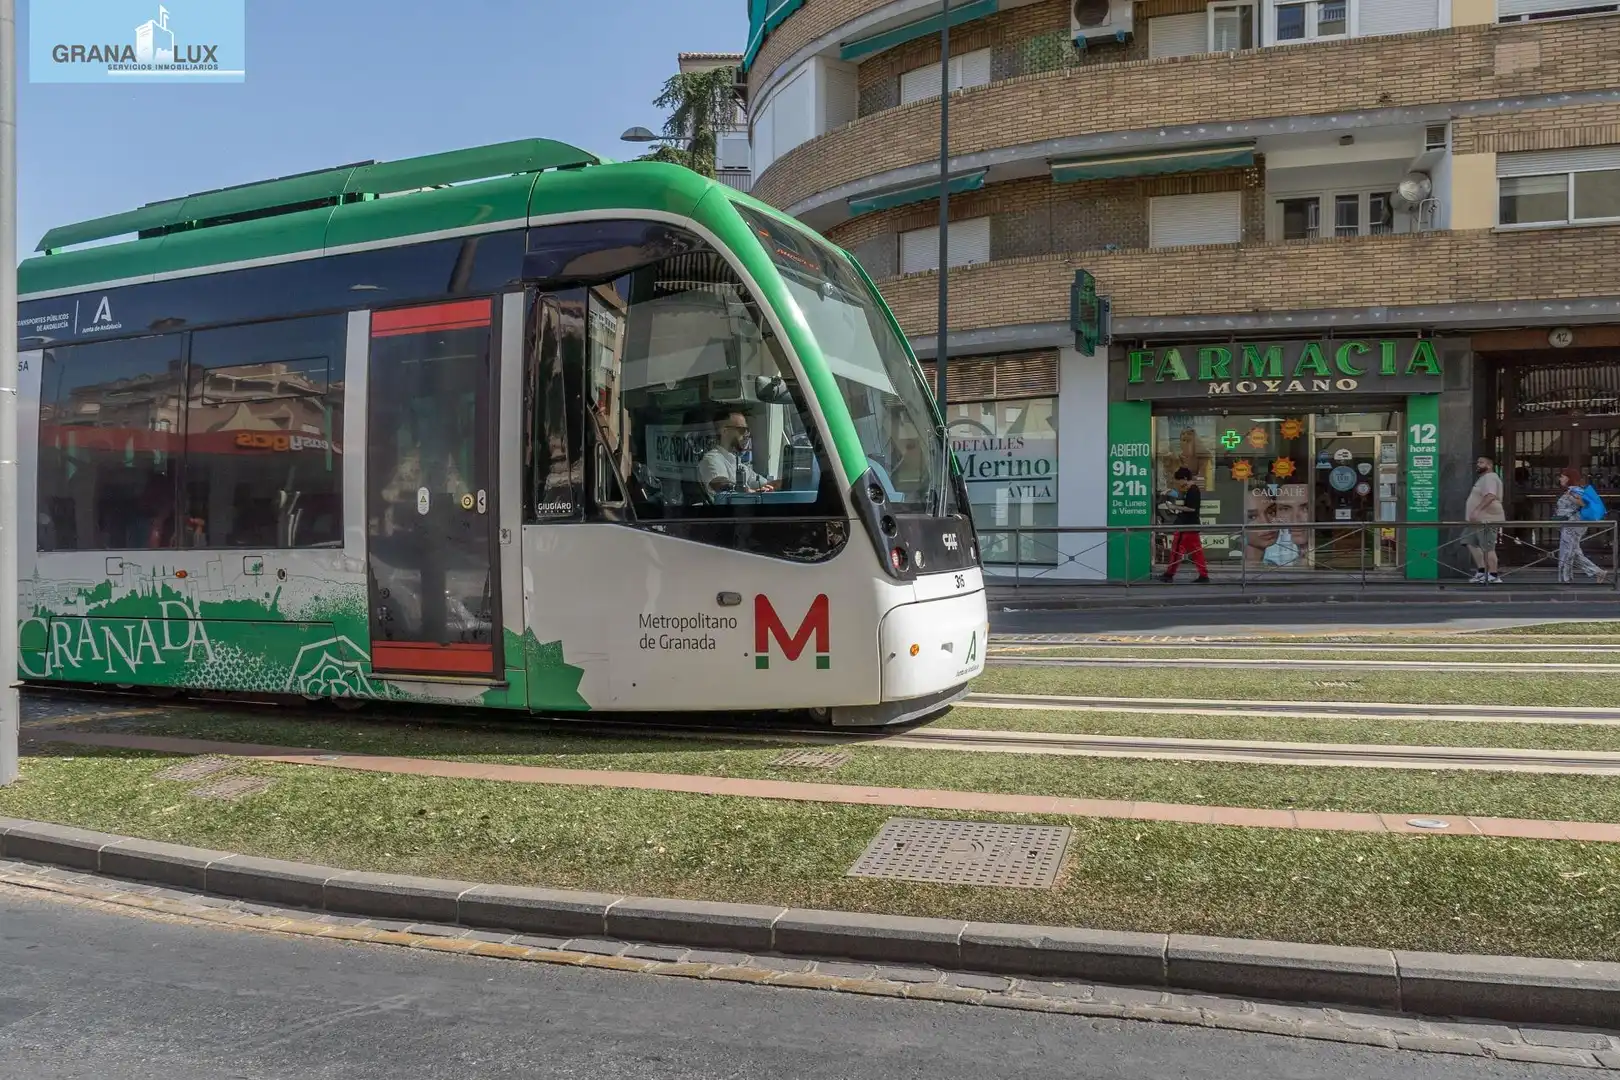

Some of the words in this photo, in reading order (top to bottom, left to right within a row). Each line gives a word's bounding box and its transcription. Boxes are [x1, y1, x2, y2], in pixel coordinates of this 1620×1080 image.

[17, 316, 46, 327] RANSPORTES
[36, 324, 43, 332] DE
[1555, 331, 1569, 344] 12
[1128, 339, 1444, 384] FARMACIA
[1207, 378, 1359, 395] MOYANO
[1410, 423, 1437, 444] 12
[952, 436, 1025, 452] DETALLES
[1110, 443, 1150, 457] ABIERTO
[1409, 444, 1437, 453] horas
[954, 451, 1051, 478] Merino
[1112, 460, 1138, 476] 9h
[1007, 481, 1052, 498] ÁVILA
[1112, 480, 1147, 496] 21h
[537, 502, 572, 510] GIUGIARO
[1112, 499, 1123, 507] De
[1125, 499, 1147, 507] Lunes
[1119, 507, 1147, 515] Viernes
[954, 574, 965, 589] 315
[638, 612, 738, 632] Metropolitano
[18, 600, 216, 677] GRANADA
[754, 593, 830, 669] M
[639, 633, 656, 650] de
[659, 632, 716, 650] Granada
